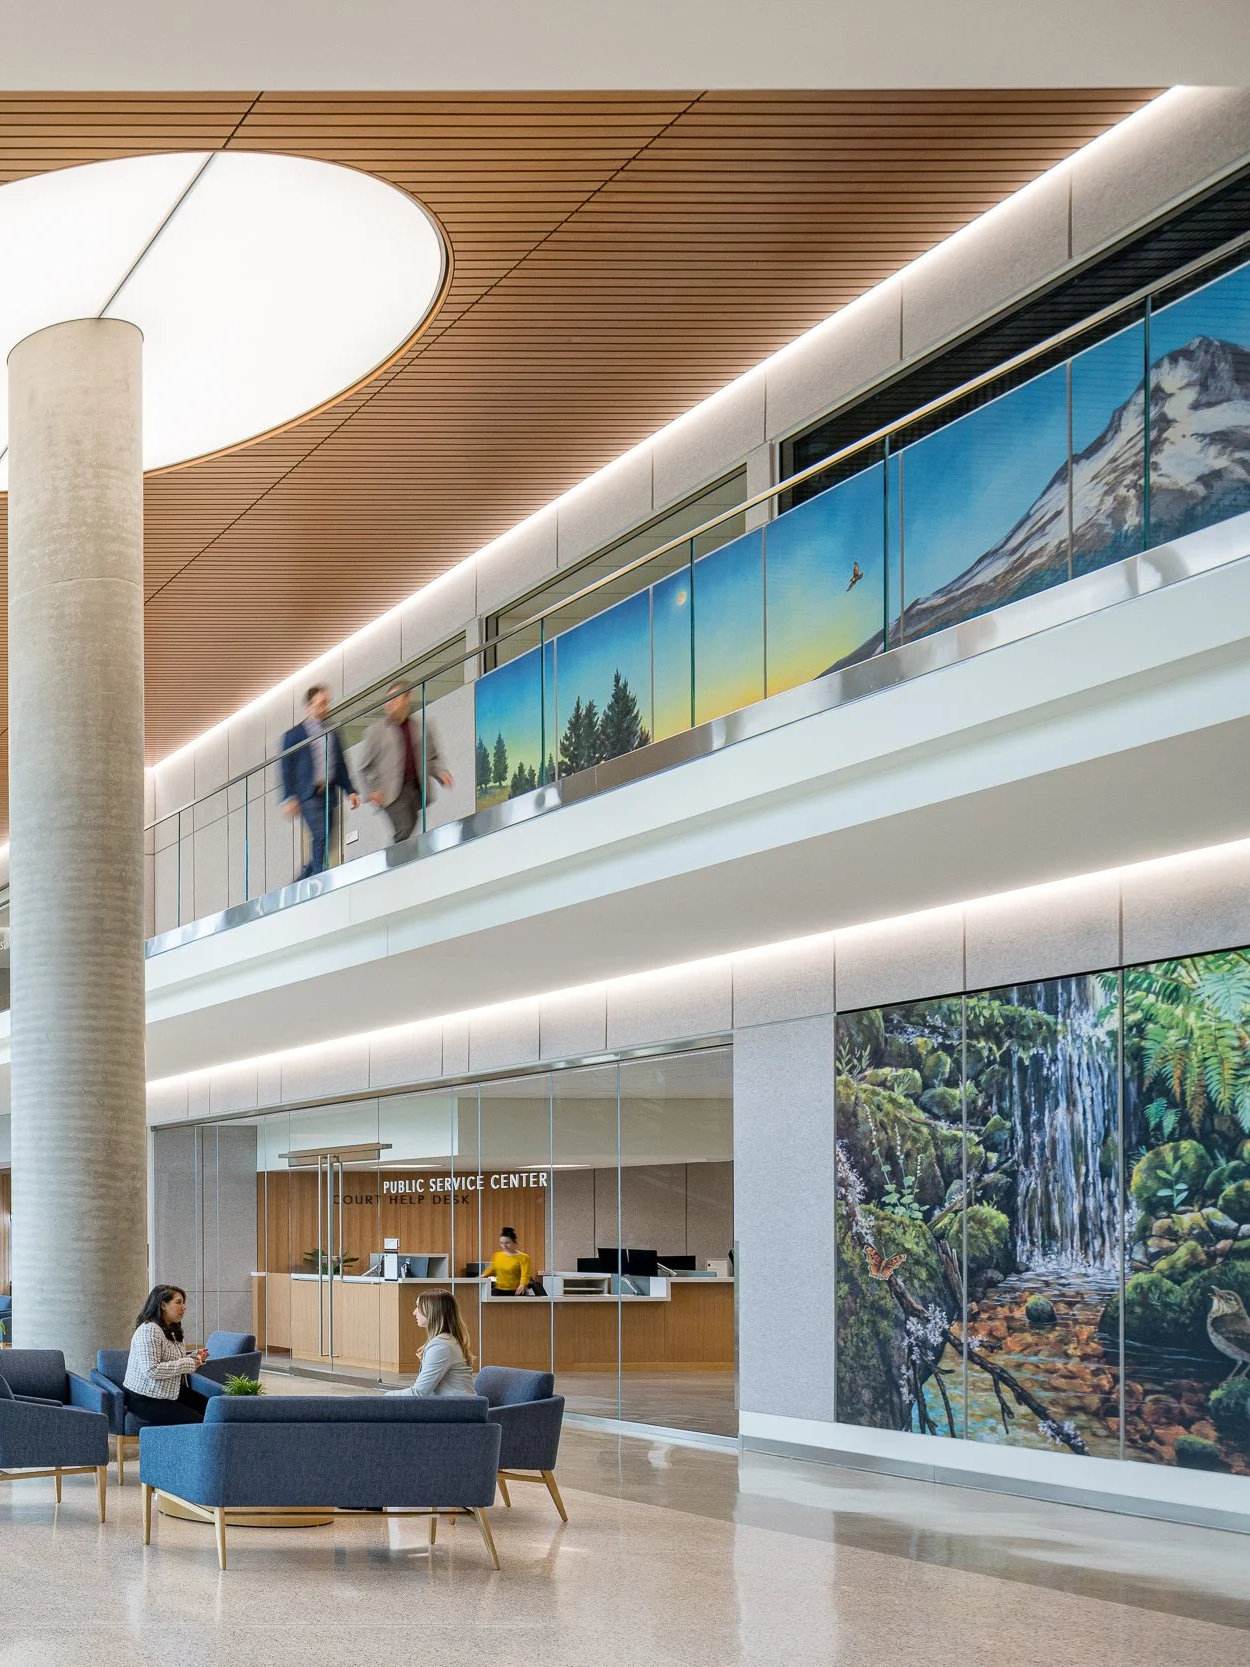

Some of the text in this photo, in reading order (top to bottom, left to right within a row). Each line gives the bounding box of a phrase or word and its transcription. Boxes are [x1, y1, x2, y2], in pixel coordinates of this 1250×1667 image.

[383, 1172, 548, 1194] PUBLIC SERVICE CENTER
[389, 1194, 425, 1205] HELP
[432, 1194, 470, 1205] DESK
